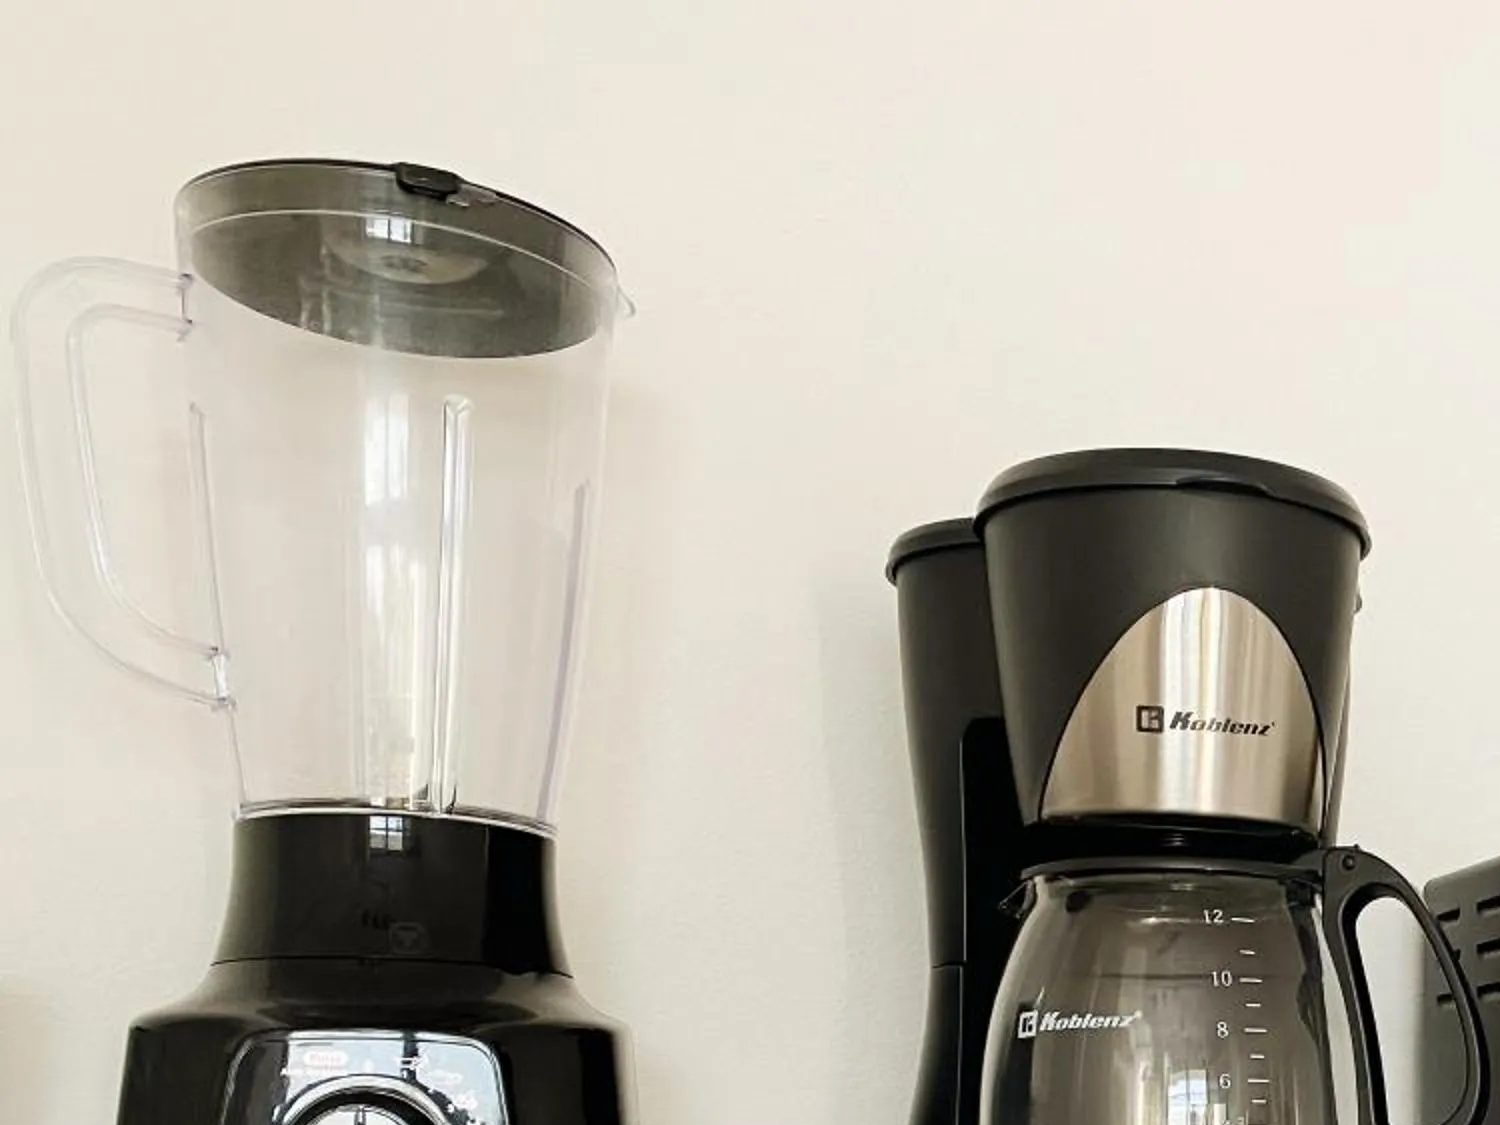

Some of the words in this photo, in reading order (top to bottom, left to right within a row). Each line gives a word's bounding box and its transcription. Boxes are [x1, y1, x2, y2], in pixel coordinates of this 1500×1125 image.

[1169, 710, 1270, 736] Koblenz
[1203, 908, 1224, 925] 12
[1211, 970, 1233, 988] 10
[1040, 1011, 1132, 1032] Koblenz
[1216, 1021, 1230, 1039] 8
[1219, 1073, 1232, 1090] 6
